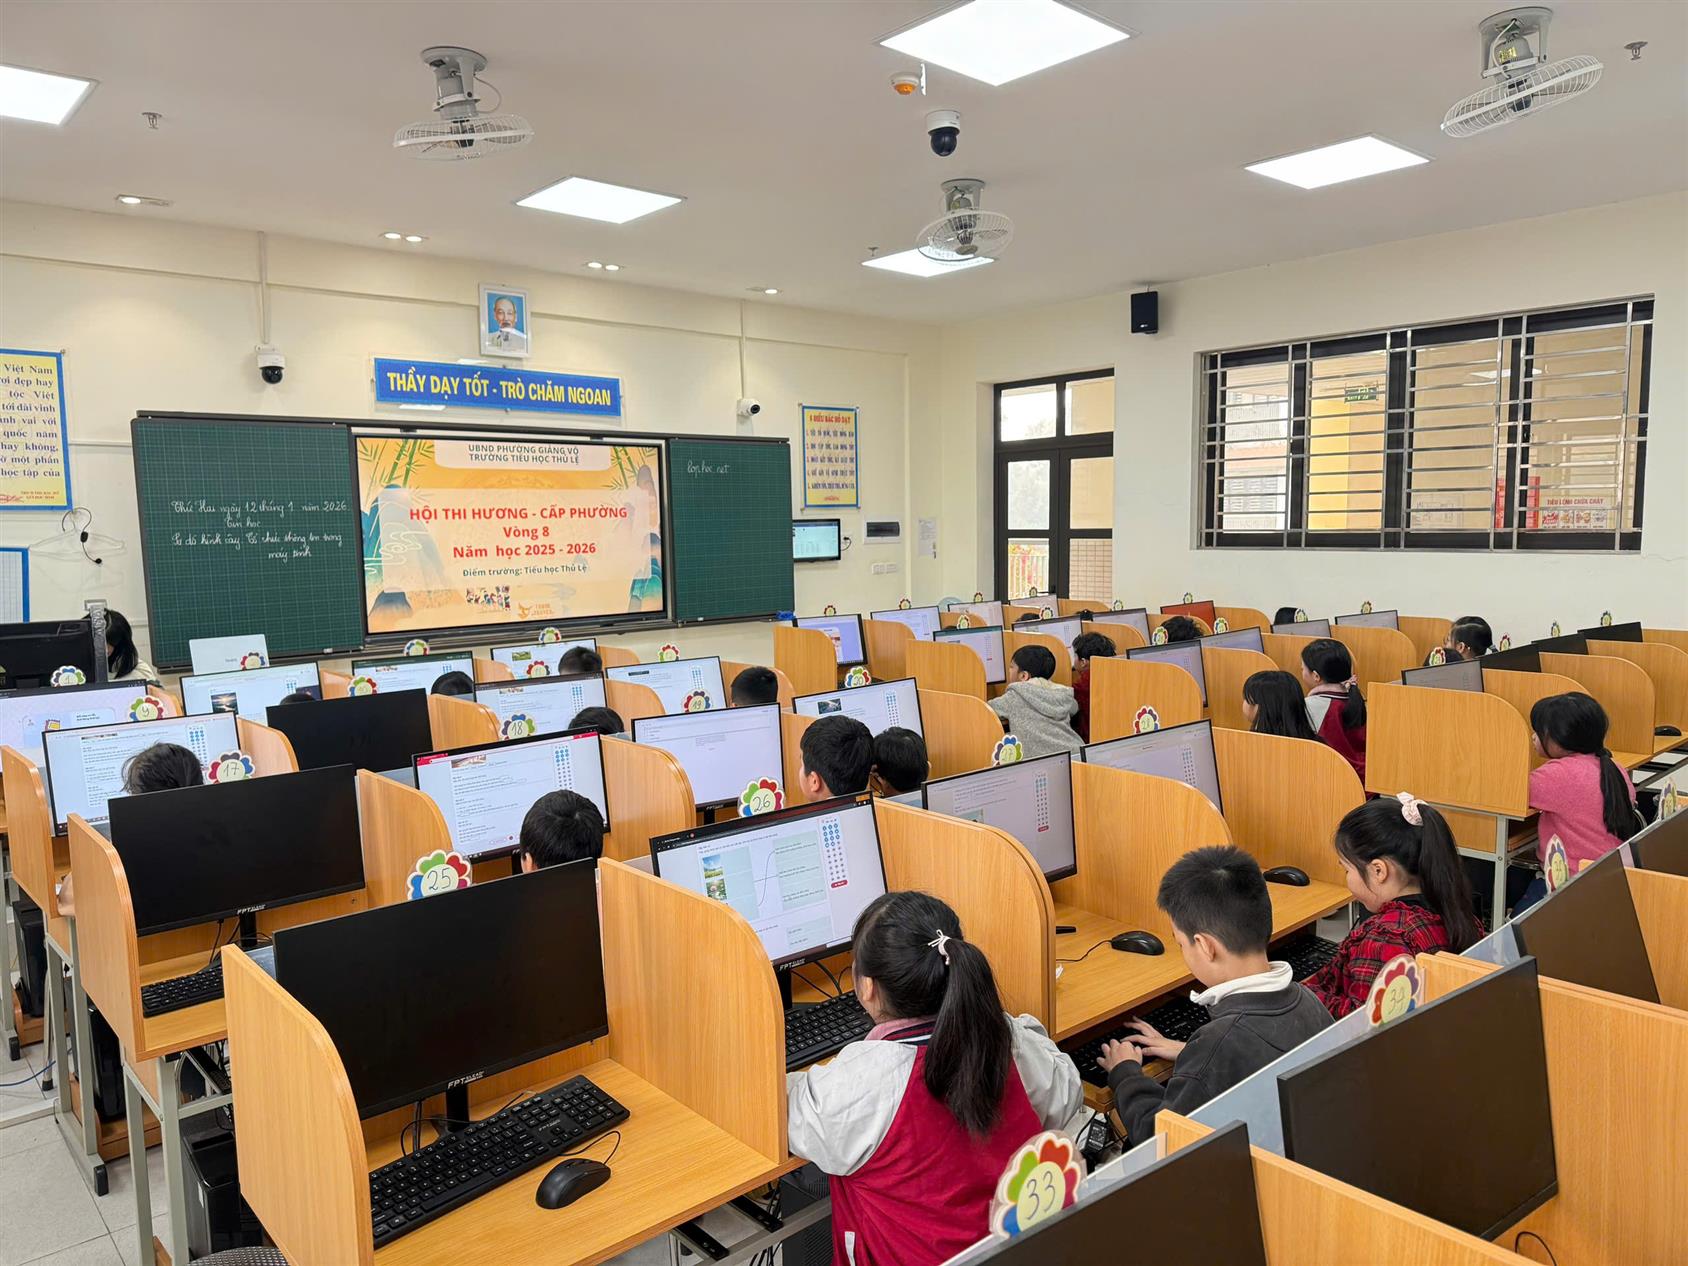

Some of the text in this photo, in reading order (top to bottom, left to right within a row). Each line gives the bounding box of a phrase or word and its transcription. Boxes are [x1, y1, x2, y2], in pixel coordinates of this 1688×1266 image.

[4, 363, 53, 374] Việt Nam
[14, 377, 32, 387] đẹp
[36, 378, 53, 388] hay
[387, 366, 426, 392] THẦY
[430, 375, 460, 400] DẠY
[463, 371, 489, 397] TỐT
[499, 377, 525, 400] TRÒ
[528, 380, 565, 403] CHĂM
[567, 386, 611, 406] NGOAN
[9, 390, 54, 400] tộc Việt
[34, 404, 55, 412] vinh
[22, 416, 36, 424] vai
[3, 428, 57, 438] quốc năm
[0, 442, 18, 452] hay
[468, 444, 494, 452] UBND
[497, 444, 536, 454] PHƯỜNG
[11, 456, 30, 465] một
[469, 453, 509, 462] TRƯỜNG
[532, 455, 549, 464] HỌC
[1, 468, 19, 478] học
[43, 468, 61, 477] của
[171, 500, 193, 513] Thứ
[195, 499, 216, 513] Hai
[220, 503, 241, 519] ngày
[245, 501, 257, 513] 12
[259, 499, 285, 518] tháng
[288, 500, 294, 512] 1
[323, 500, 347, 512] 2026
[409, 505, 438, 524] HỘI
[442, 508, 467, 520] THI
[472, 507, 528, 520] HƯƠNG
[540, 504, 566, 519] CẤP
[570, 504, 628, 519] PHƯỜNG
[503, 525, 550, 541] Vòng 8
[453, 545, 488, 558] Năm
[496, 545, 521, 560] học
[525, 544, 556, 556] 2025
[566, 542, 596, 554] 2026
[463, 567, 486, 577] Điểm
[488, 567, 522, 577] trường:
[544, 564, 559, 575] học
[511, 720, 523, 736] 18
[224, 761, 239, 777] 17
[752, 793, 771, 812] 26
[427, 867, 451, 890] 25
[447, 1077, 466, 1090] FPT
[1026, 1170, 1056, 1220] 33
